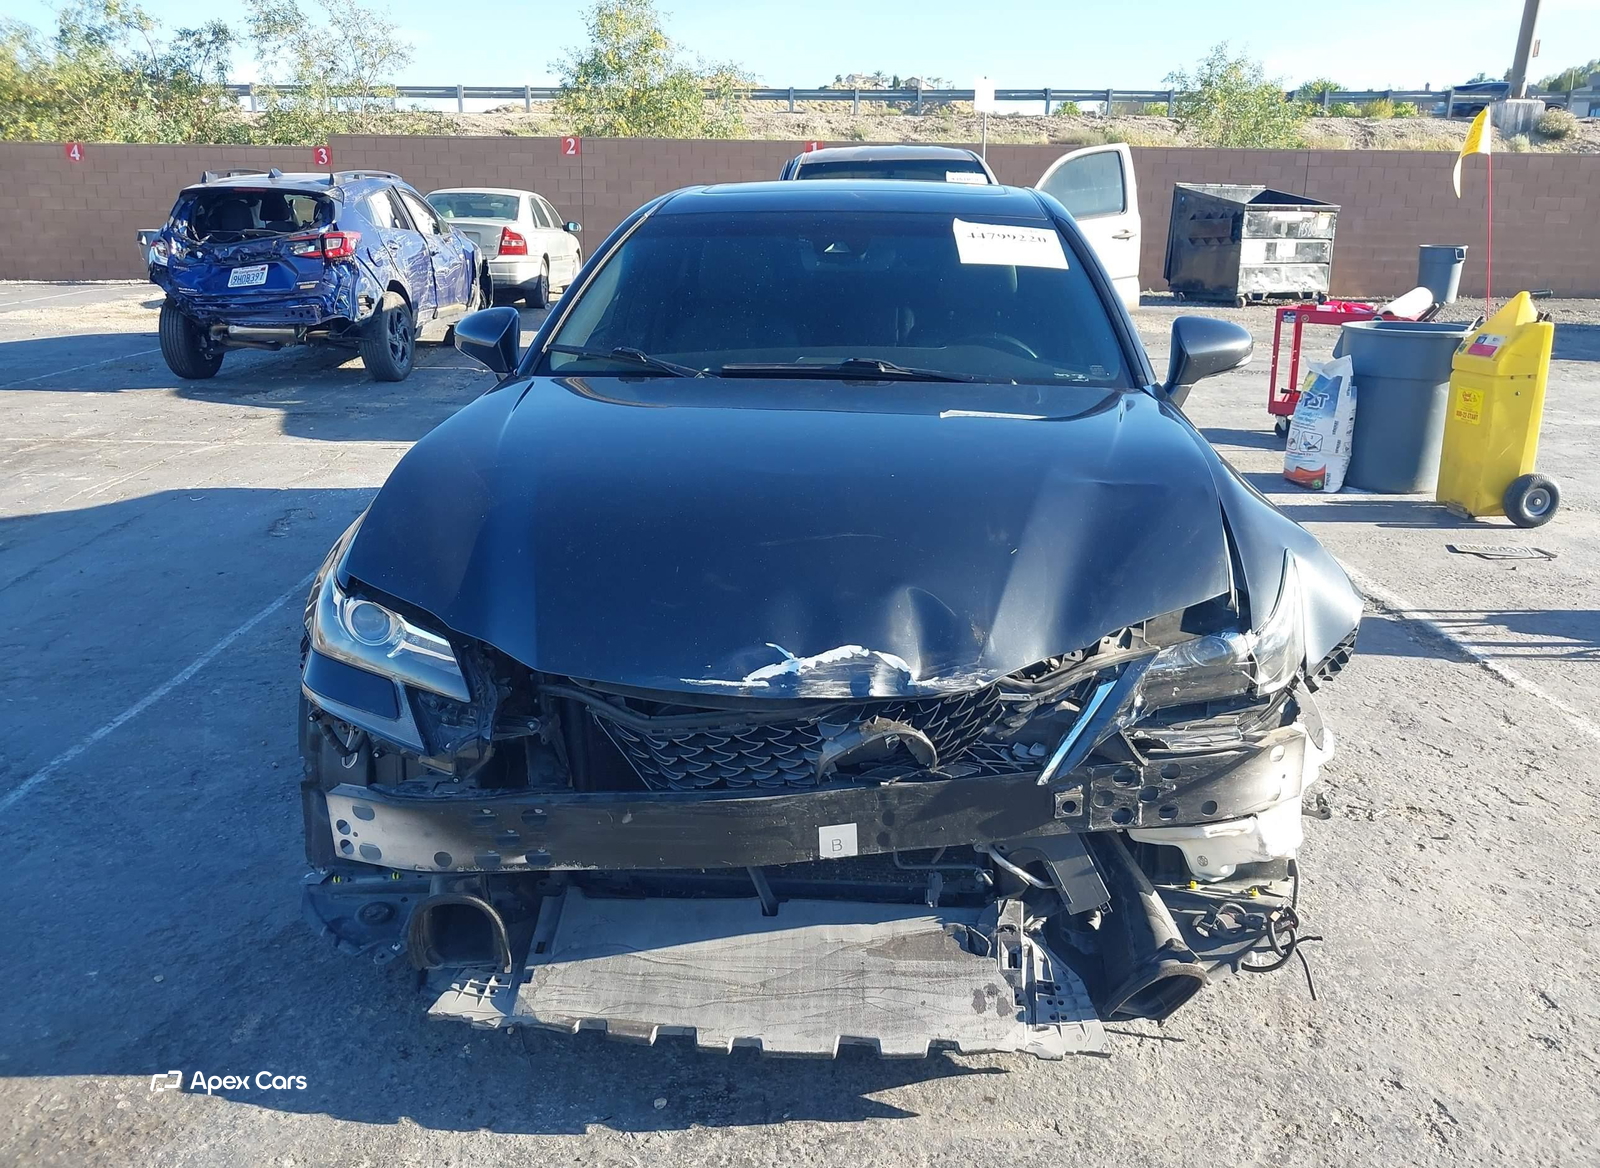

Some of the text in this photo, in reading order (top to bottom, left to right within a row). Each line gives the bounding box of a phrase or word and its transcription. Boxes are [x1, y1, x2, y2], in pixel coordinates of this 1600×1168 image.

[70, 144, 80, 160] 4
[566, 138, 576, 154] 2
[317, 148, 328, 165] 3
[831, 838, 843, 852] B
